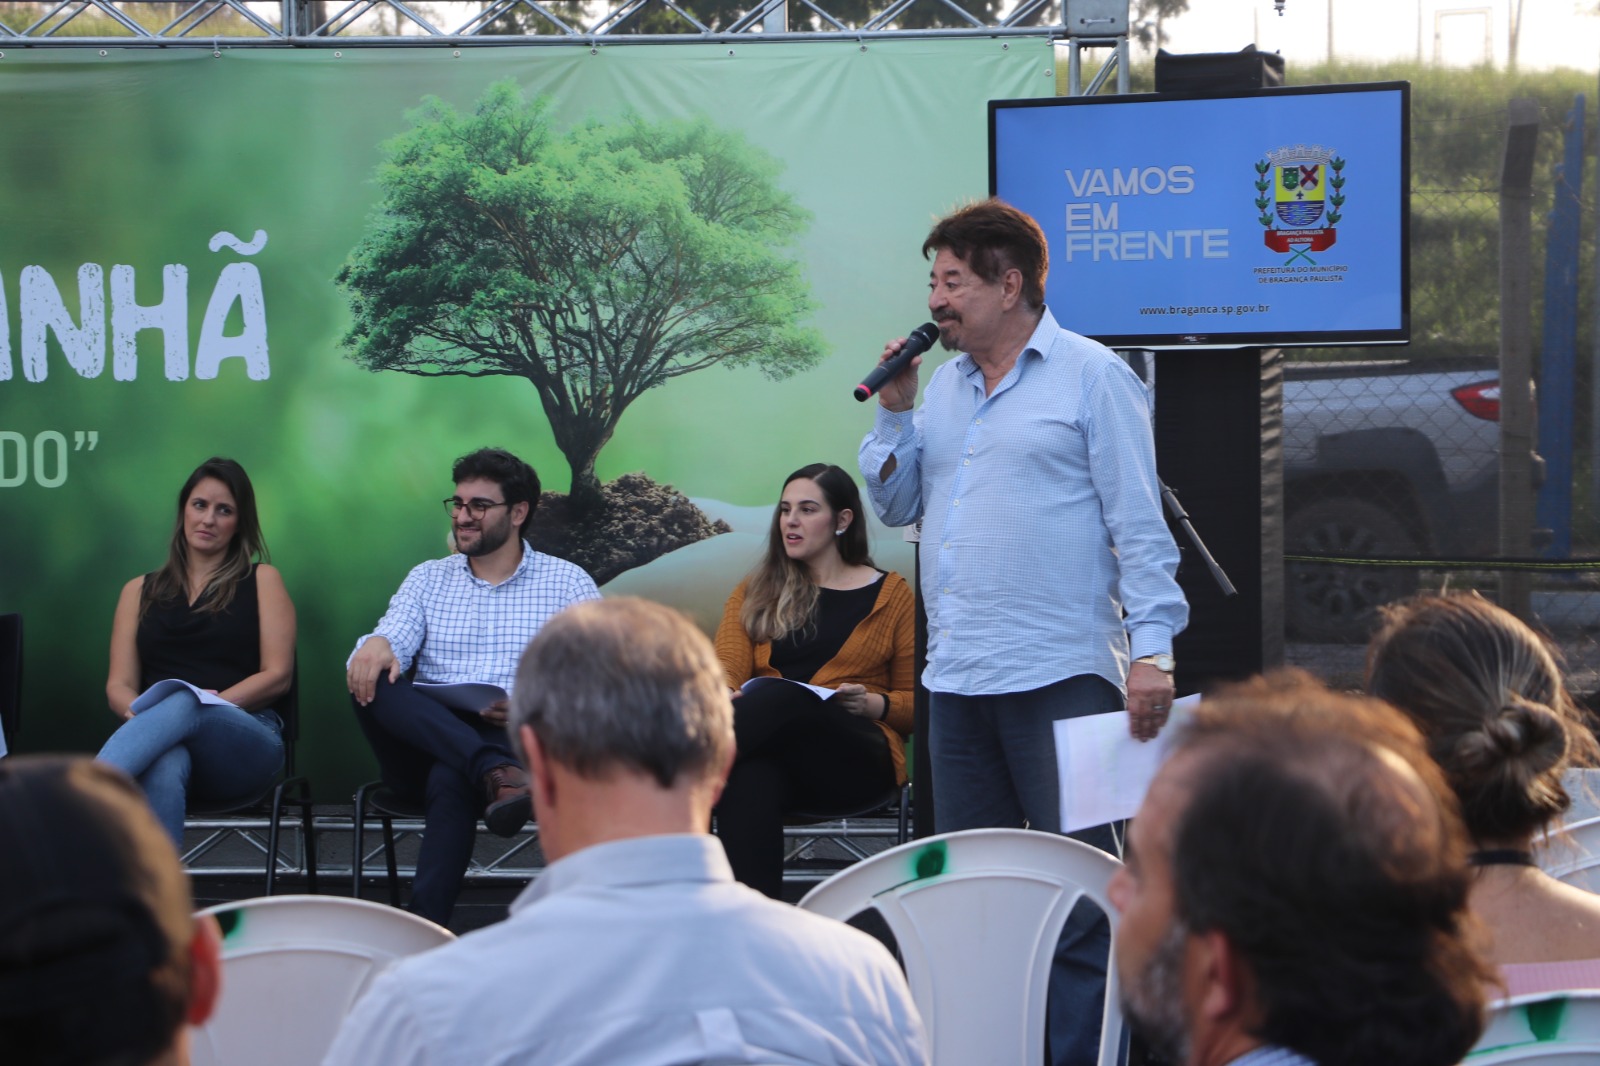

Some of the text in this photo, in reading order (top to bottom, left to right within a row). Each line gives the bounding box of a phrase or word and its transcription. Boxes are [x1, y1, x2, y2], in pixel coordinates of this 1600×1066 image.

[1065, 165, 1195, 197] VAMOS
[1065, 202, 1118, 231] EM
[1066, 229, 1229, 262] FRENTE
[1309, 264, 1348, 273] MUNICÍPIO
[1309, 275, 1344, 283] PAULISTA
[0, 230, 270, 382] NHÃ
[1139, 304, 1270, 316] www.braganca.sp.gov.br
